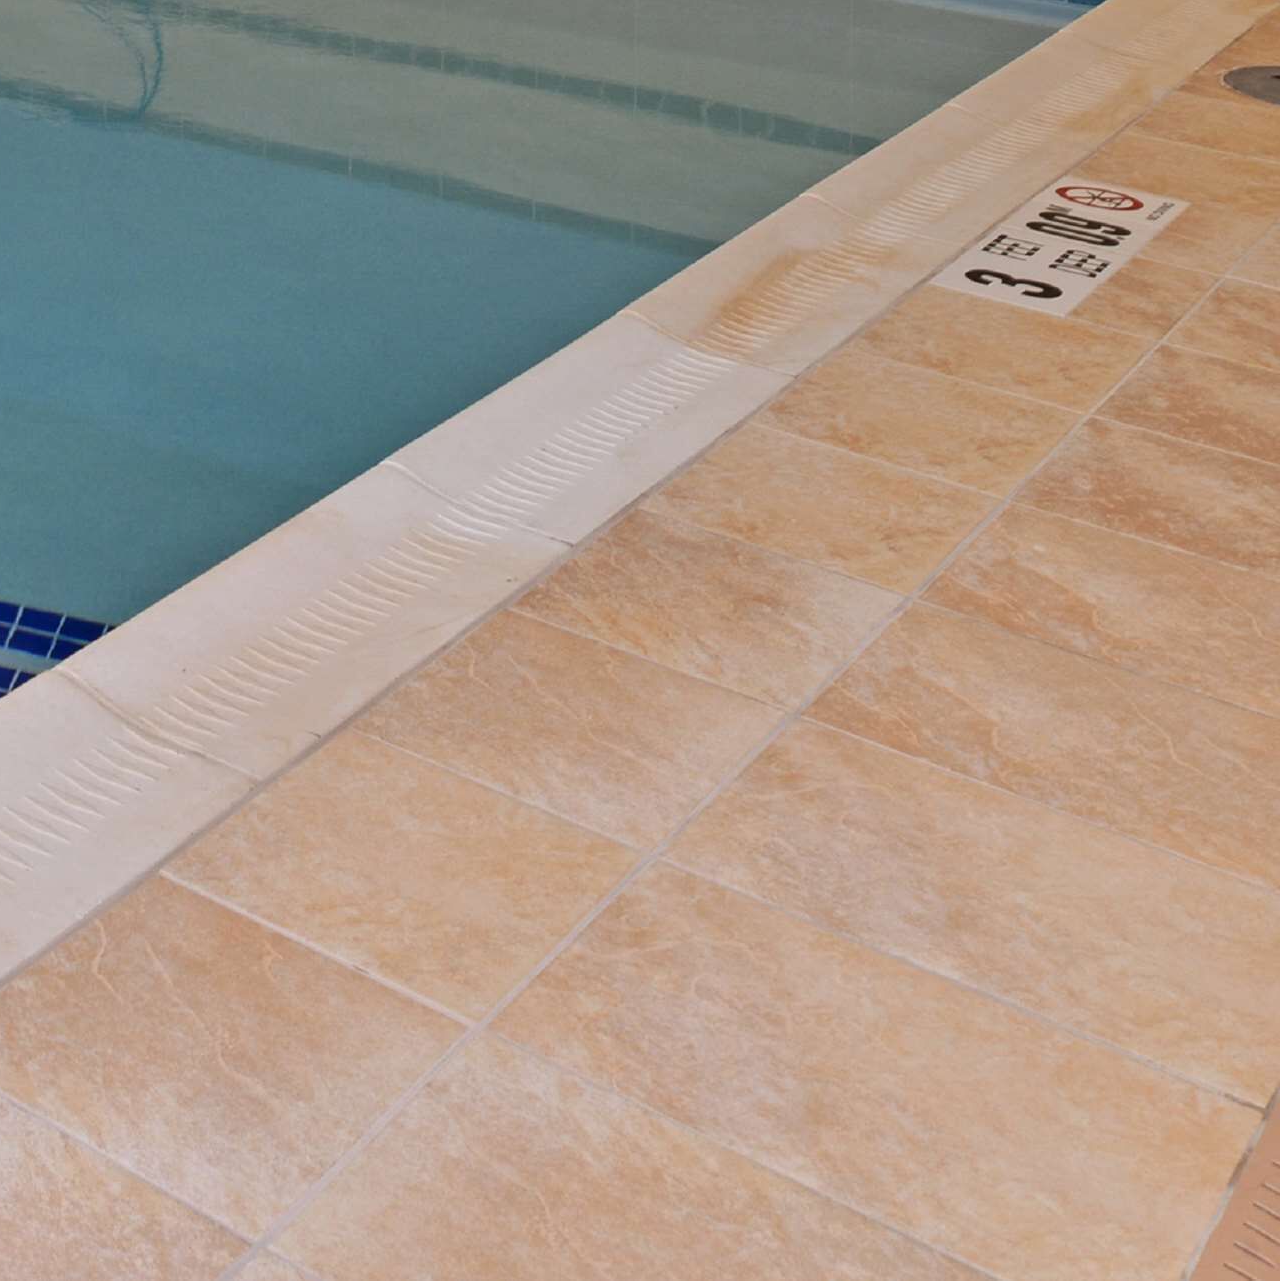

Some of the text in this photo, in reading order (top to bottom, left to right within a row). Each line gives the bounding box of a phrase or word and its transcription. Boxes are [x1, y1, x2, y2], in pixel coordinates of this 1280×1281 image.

[982, 234, 1044, 261] FEET
[1048, 249, 1111, 279] DEEP
[964, 269, 1063, 299] 3
